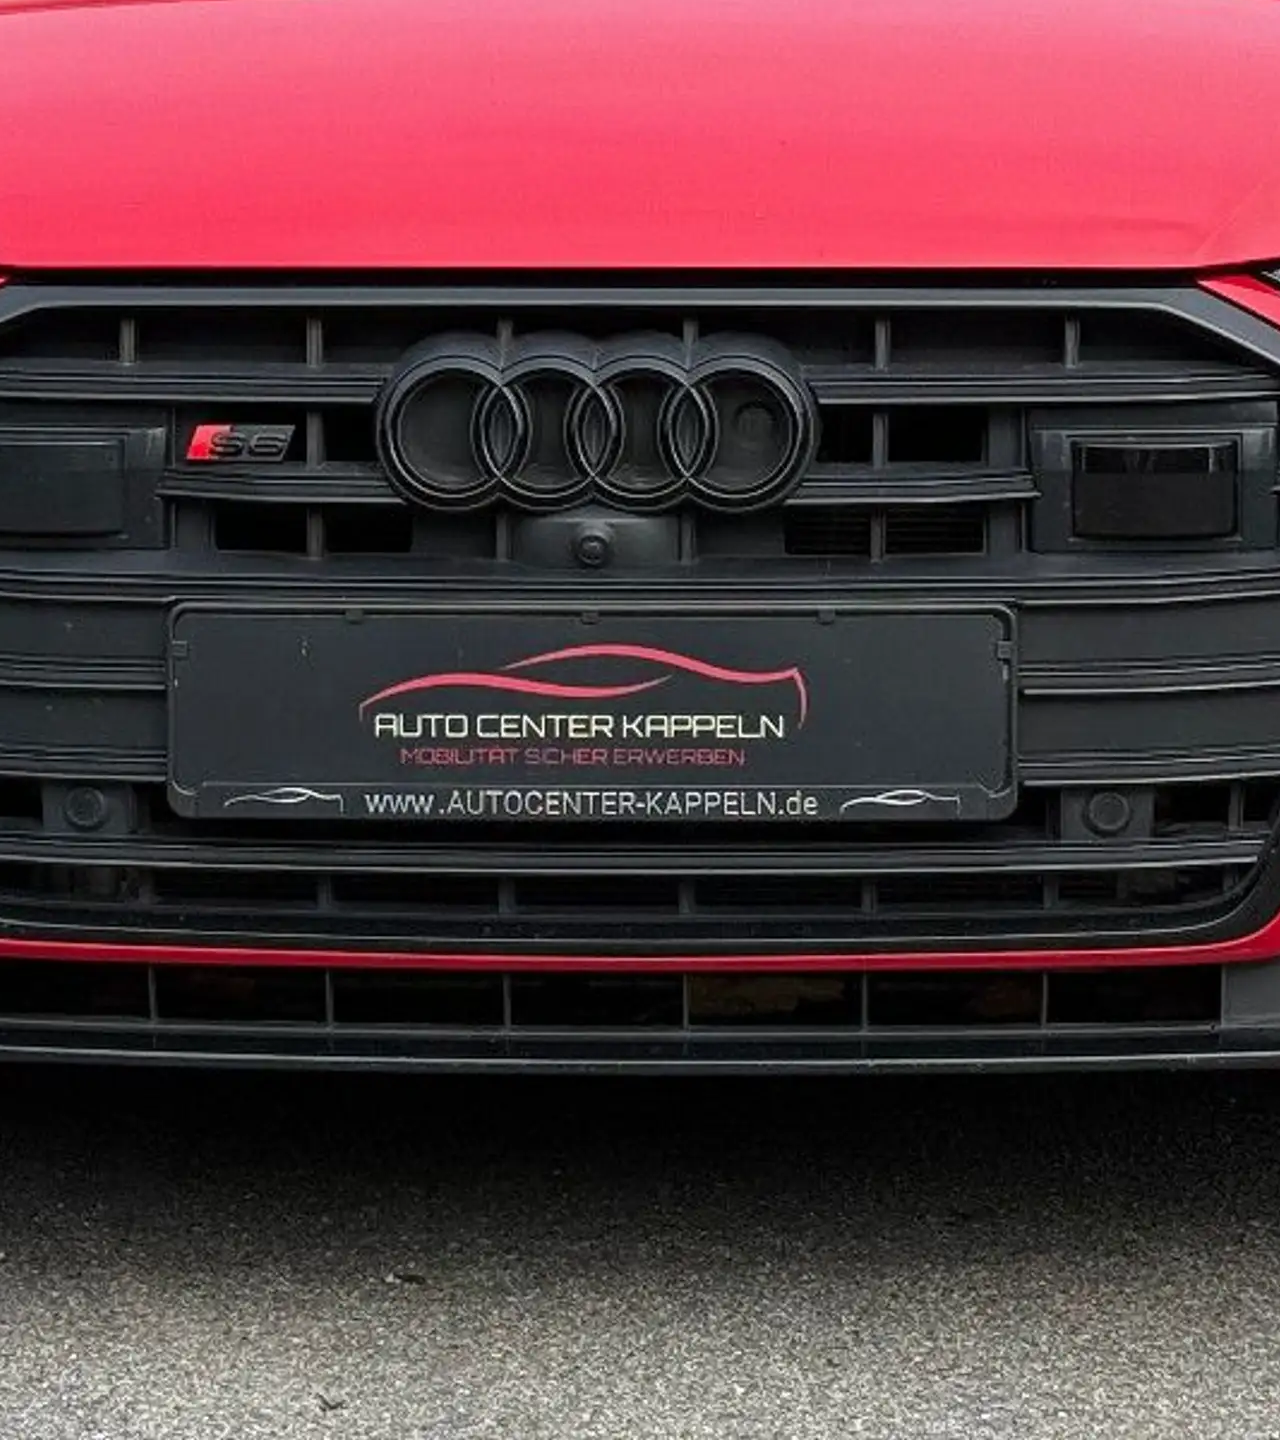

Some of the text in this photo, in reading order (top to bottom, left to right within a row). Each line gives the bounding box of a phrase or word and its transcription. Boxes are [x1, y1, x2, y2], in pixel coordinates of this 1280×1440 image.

[211, 431, 286, 456] S6
[374, 713, 784, 739] AUTO CENTER KAPPELN
[524, 747, 609, 766] SICHER
[612, 747, 745, 766] ERWERBEN
[364, 789, 819, 816] www.AUTOCENTER-KAPPELN.de
